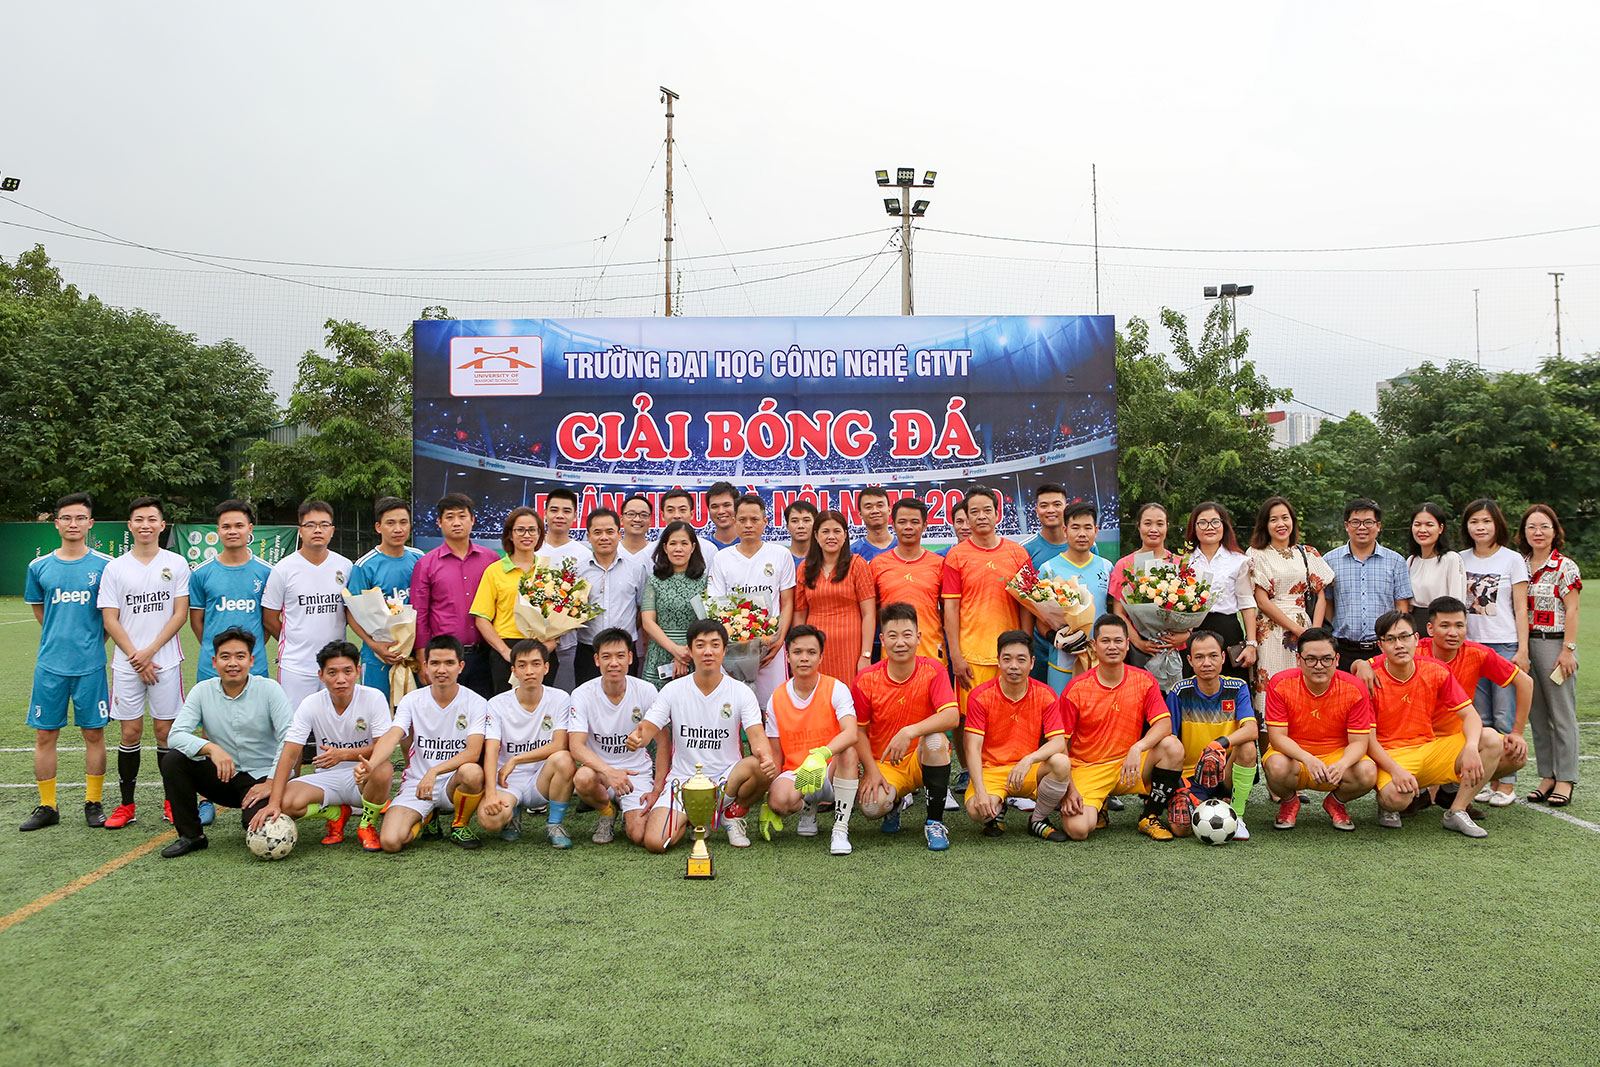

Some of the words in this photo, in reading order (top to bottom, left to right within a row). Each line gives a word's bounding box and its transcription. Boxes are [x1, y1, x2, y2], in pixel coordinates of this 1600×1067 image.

[564, 345, 661, 380] TRƯỜNG
[666, 350, 709, 384] ĐẠI
[715, 350, 764, 384] HỌC
[770, 344, 837, 378] CÔNG
[843, 344, 909, 383] NGHỆ
[915, 349, 972, 378] GTVT
[556, 392, 693, 462] GIẢI
[705, 397, 877, 461] BÓNG
[889, 396, 981, 461] ĐÁ
[840, 483, 915, 526] NM
[925, 489, 1003, 526] 20
[52, 588, 91, 605] Jeep
[126, 591, 171, 606] Emirates
[215, 596, 256, 612] Jeep
[298, 593, 343, 606] Emirate
[98, 700, 109, 719] 8
[680, 725, 729, 739] Emirates
[417, 735, 467, 749] Emirates
[686, 739, 697, 748] FLY
[423, 750, 434, 759] FLY
